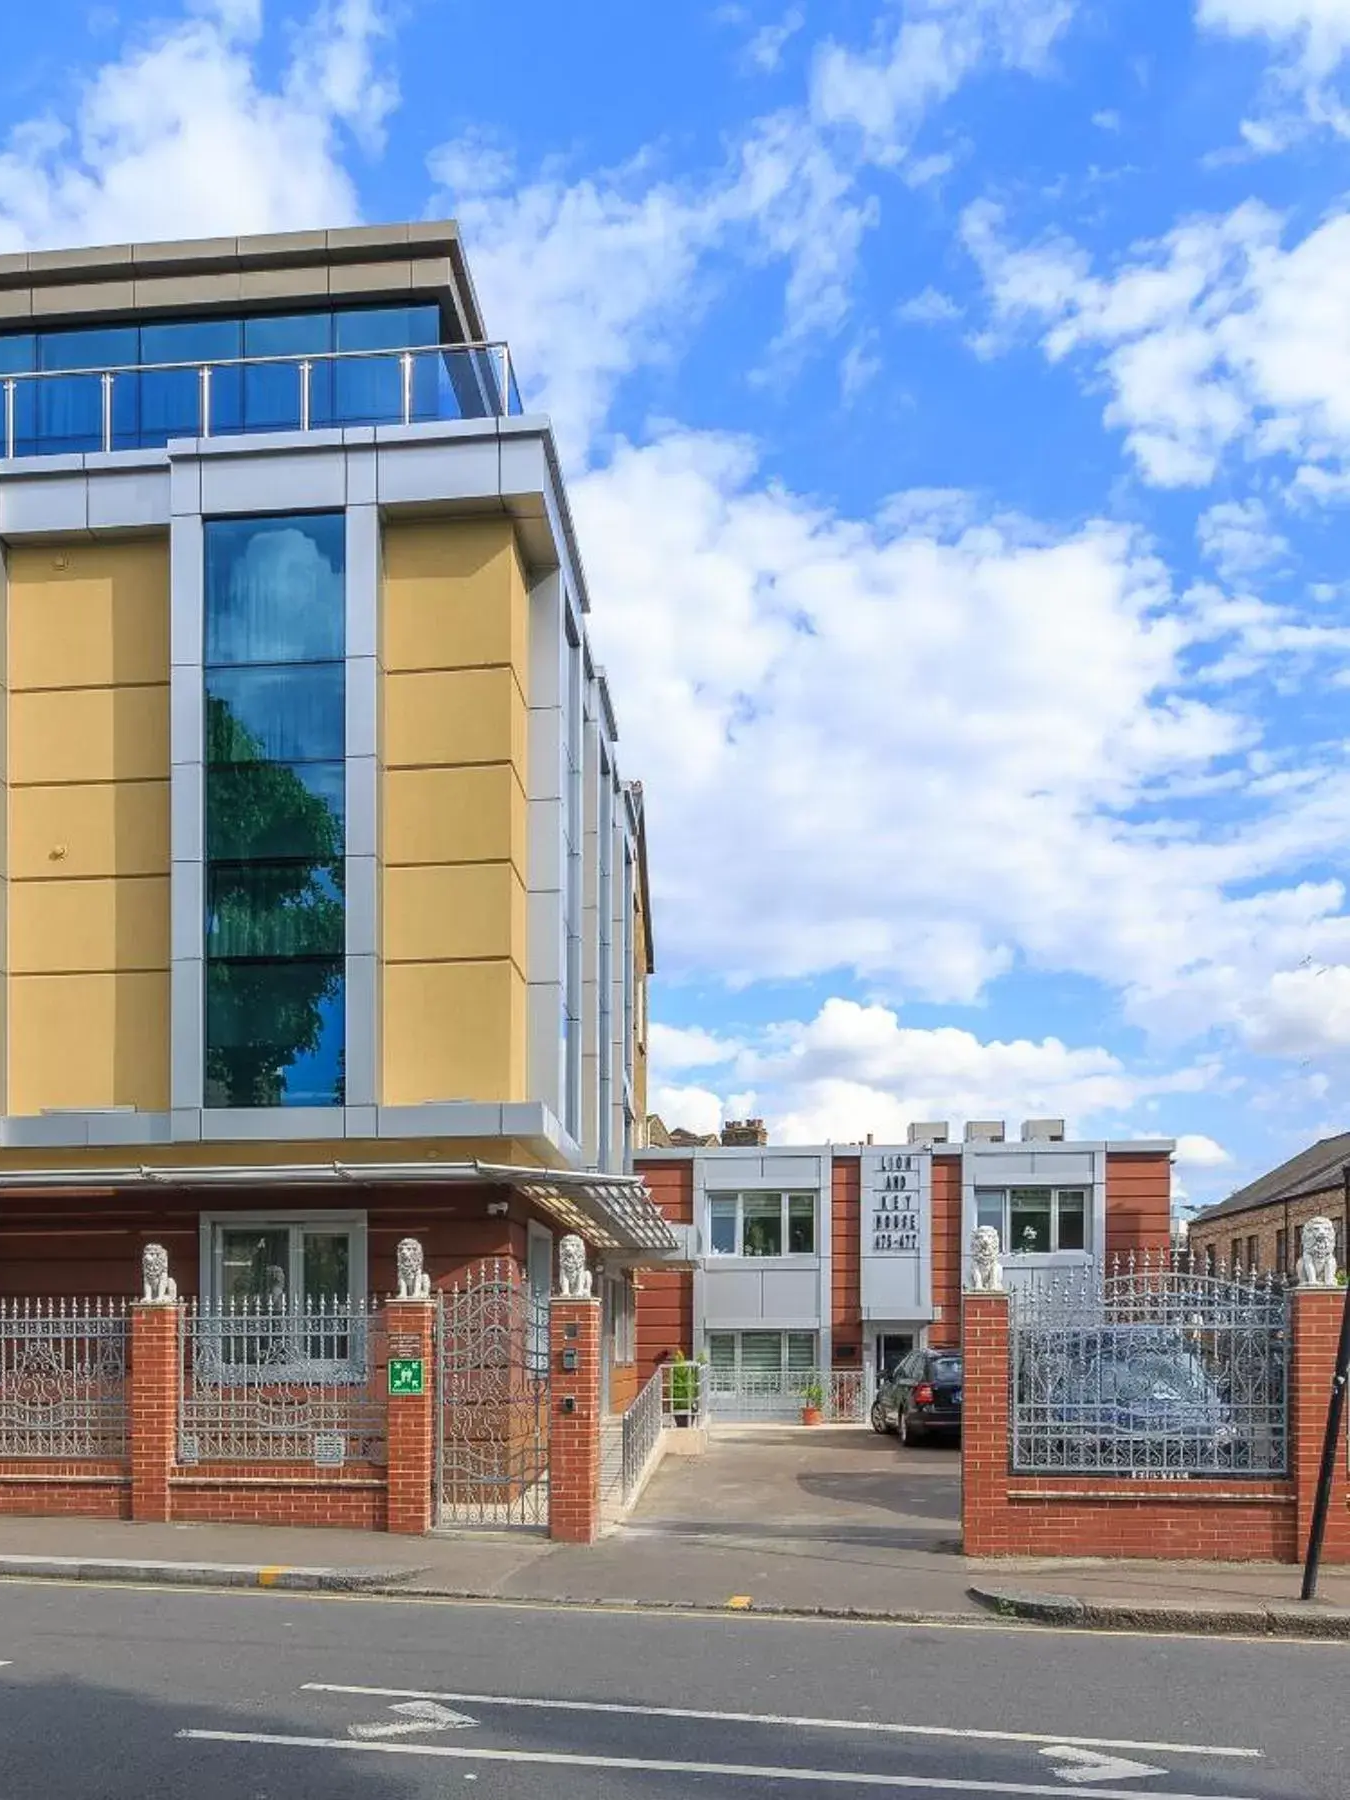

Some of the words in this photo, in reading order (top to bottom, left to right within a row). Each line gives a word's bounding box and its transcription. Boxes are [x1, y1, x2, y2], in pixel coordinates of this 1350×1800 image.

[881, 1156, 911, 1171] LION
[886, 1175, 906, 1190] AND
[881, 1195, 911, 1210] KEY
[876, 1215, 916, 1230] HOUSE
